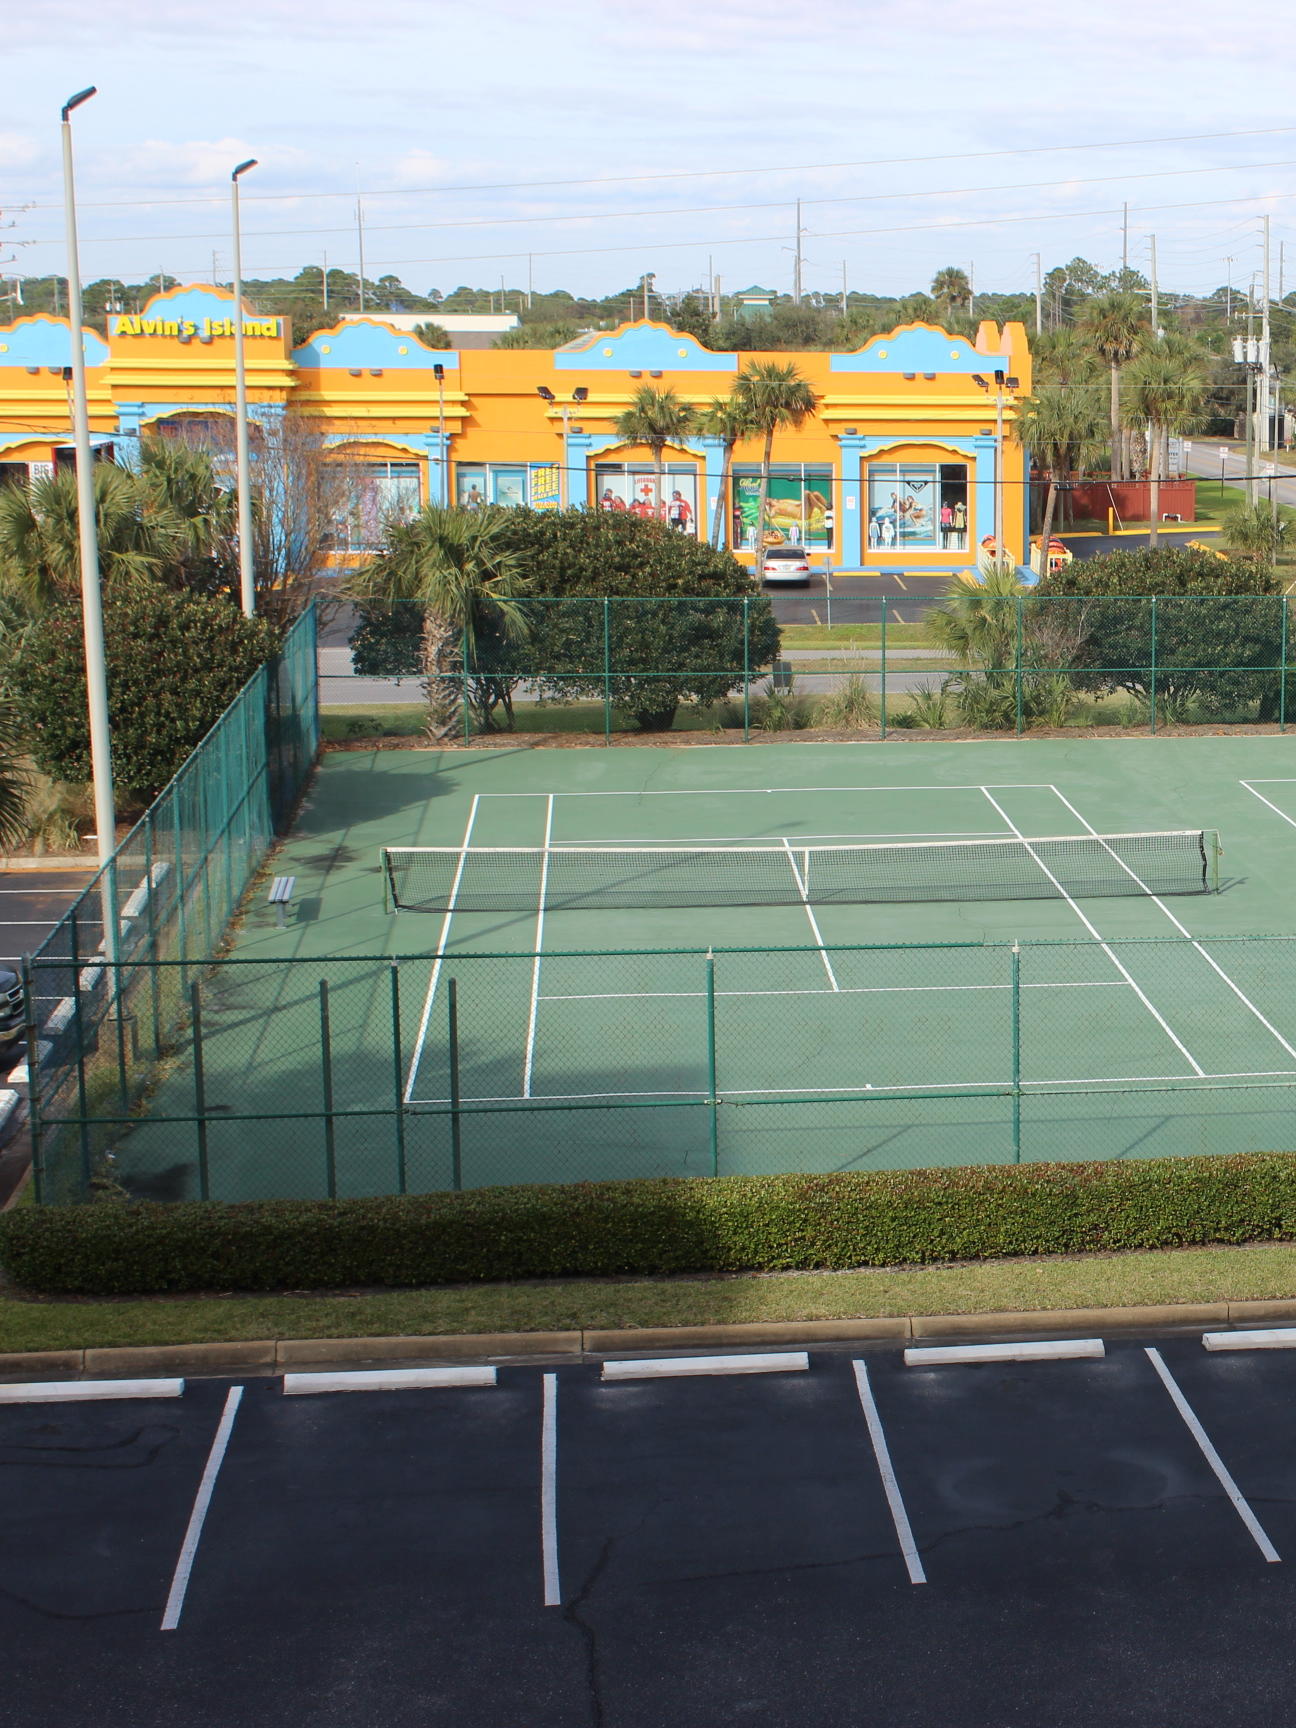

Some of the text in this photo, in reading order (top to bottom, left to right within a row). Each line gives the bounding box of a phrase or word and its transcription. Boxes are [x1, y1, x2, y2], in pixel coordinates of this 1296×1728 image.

[114, 316, 196, 336] Alvin's
[531, 464, 559, 479] FREE
[531, 473, 559, 487] FREE
[531, 481, 559, 496] FREE
